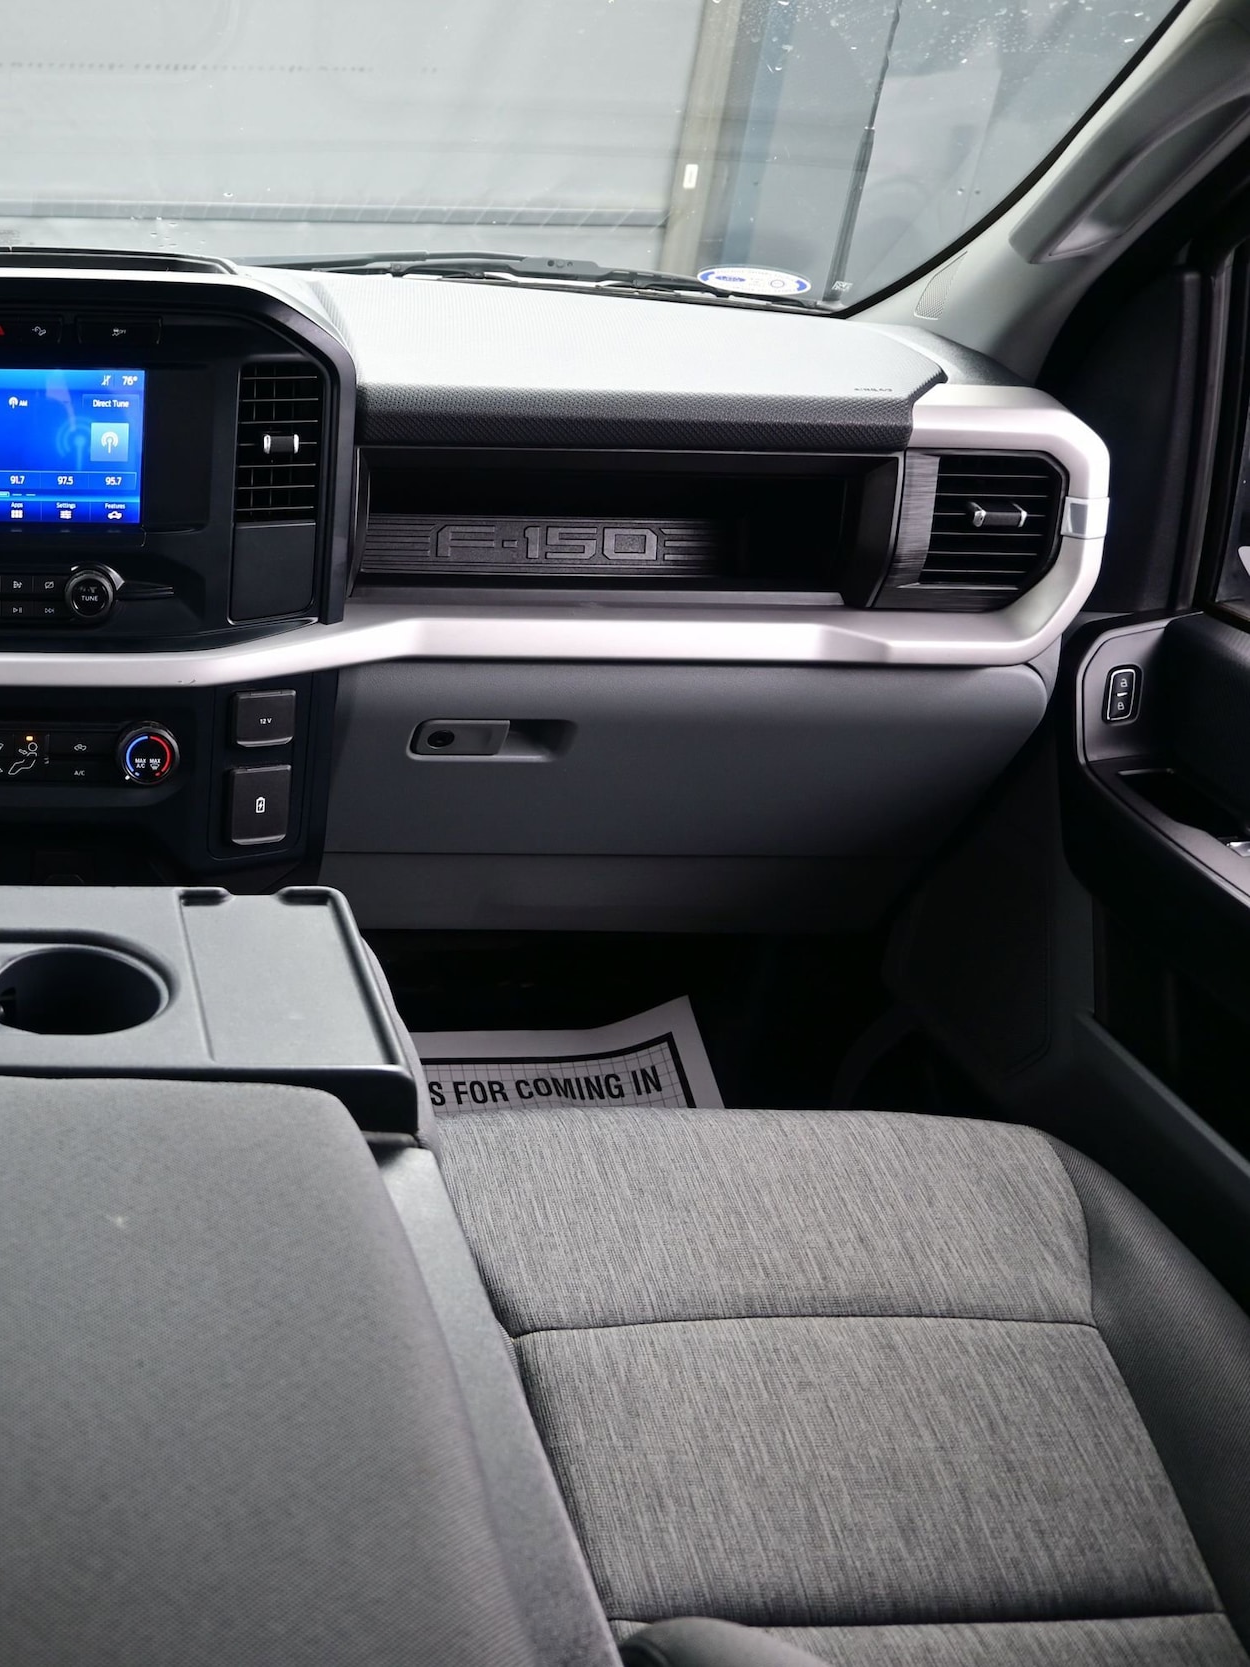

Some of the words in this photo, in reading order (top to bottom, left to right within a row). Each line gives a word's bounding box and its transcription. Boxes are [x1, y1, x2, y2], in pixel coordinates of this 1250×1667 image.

[92, 399, 111, 408] Direct
[113, 399, 130, 408] Tune
[10, 475, 25, 485] 91.7
[57, 476, 74, 485] 97.5
[105, 476, 122, 486] 95.7
[437, 525, 658, 560] F-150
[453, 1080, 509, 1105] FOR
[515, 1073, 626, 1101] COMING
[631, 1065, 663, 1096] IN
